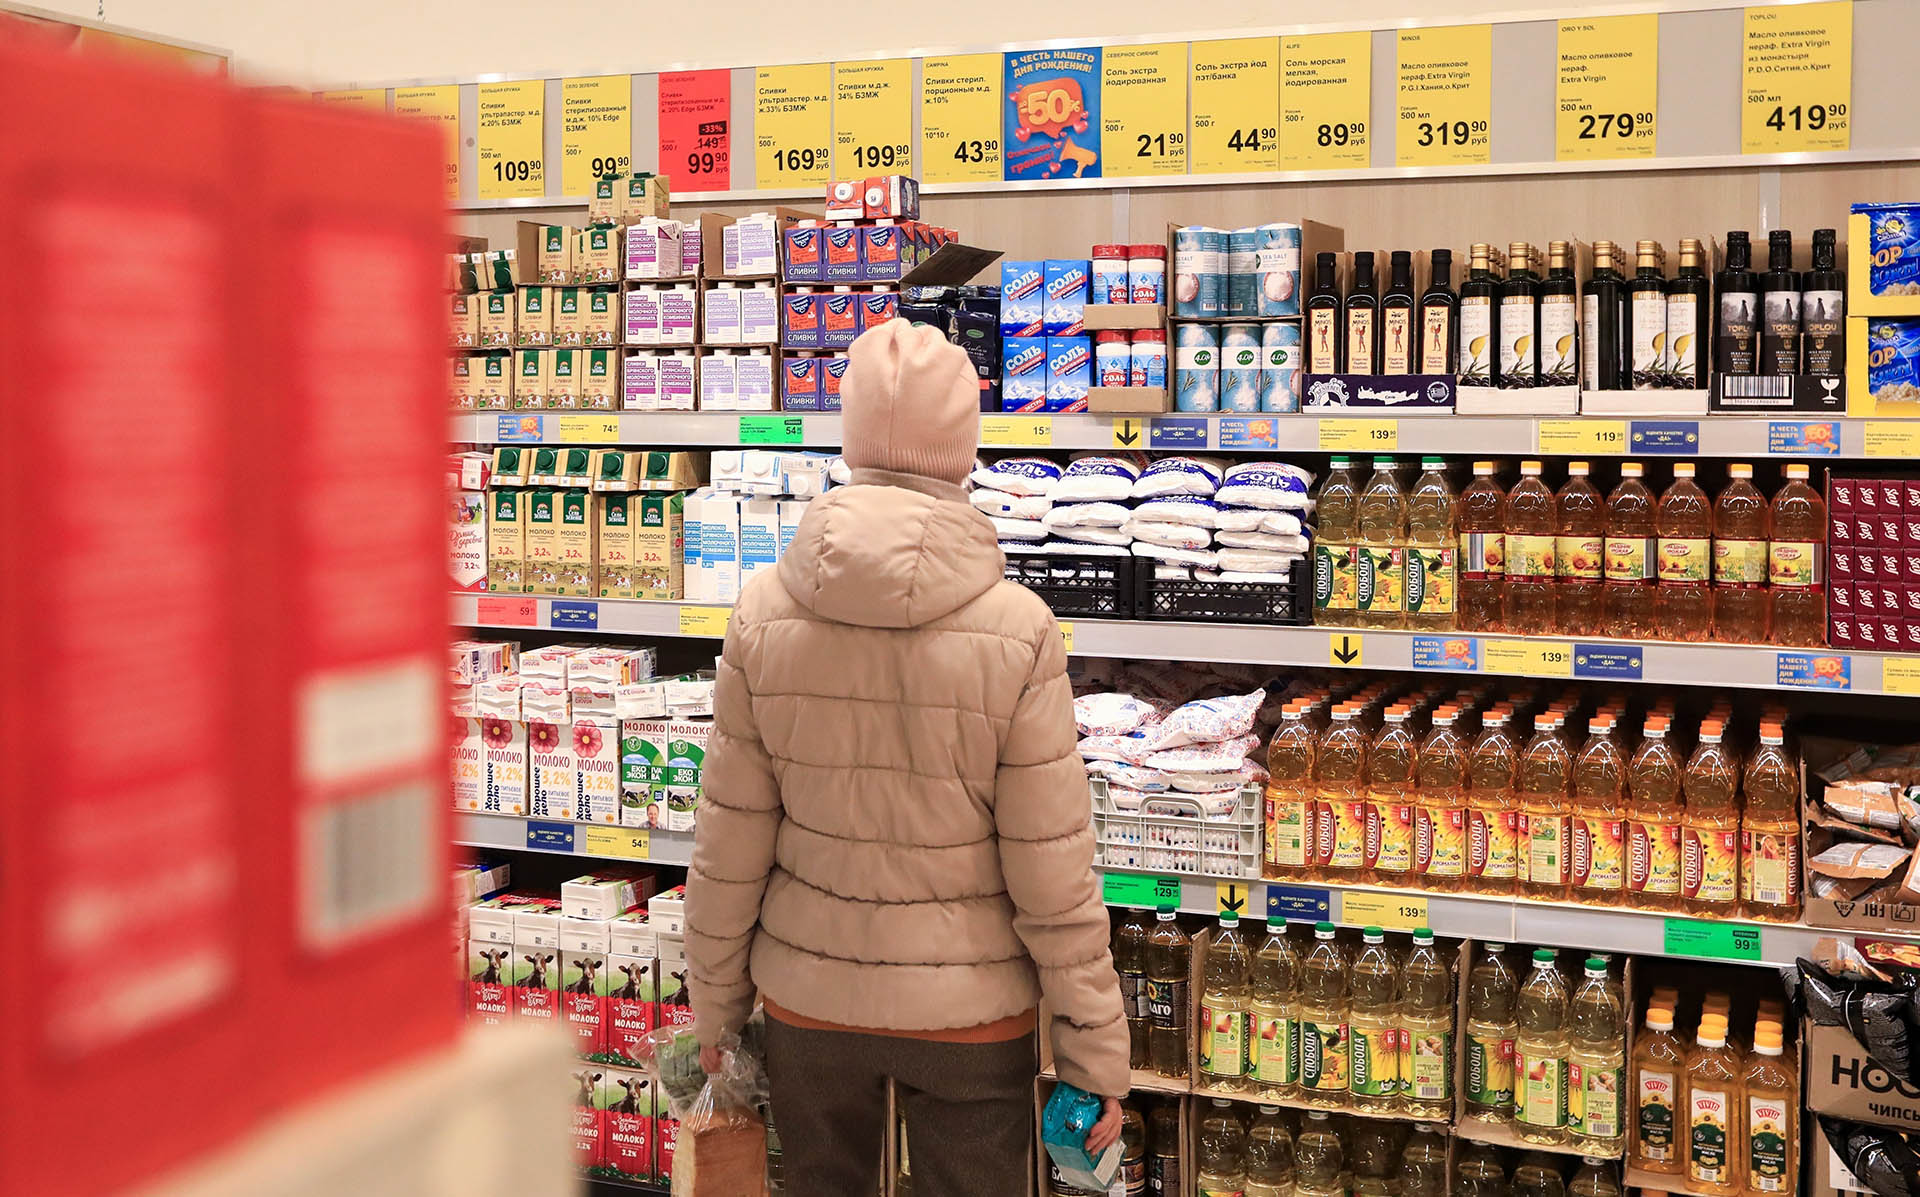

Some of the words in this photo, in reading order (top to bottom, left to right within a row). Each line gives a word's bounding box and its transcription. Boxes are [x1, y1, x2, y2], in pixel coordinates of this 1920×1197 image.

[1749, 31, 1776, 39] Масло
[1779, 29, 1826, 38] оливковое
[1781, 41, 1804, 49] Extra
[1806, 39, 1831, 48] Virgin
[1011, 59, 1018, 67] В
[1020, 52, 1050, 63] ЧЕСТЬ
[1054, 51, 1094, 62] НАШЕГО
[1286, 59, 1307, 67] Соль
[1310, 57, 1346, 66] морская
[1561, 54, 1586, 62] Масло
[1589, 52, 1632, 60] оливковое
[1760, 52, 1809, 61] монастыря
[1014, 66, 1033, 78] ДНЯ
[1035, 61, 1092, 72] РОЖДЕНИЯ!
[1195, 64, 1217, 72] Соль
[1220, 61, 1248, 70] экстра
[1251, 59, 1267, 68] йод
[1401, 62, 1424, 70] Масло
[1427, 60, 1468, 68] оливковое
[1106, 68, 1127, 76] Соль
[1130, 67, 1157, 75] экстра
[1195, 72, 1236, 81] пэт/банка
[1286, 69, 1318, 77] мелкая,
[1448, 70, 1470, 79] Virgin
[925, 77, 953, 86] Сливки
[957, 77, 986, 85] стерил.
[1106, 76, 1167, 86] йодированная
[1286, 76, 1347, 87] йодированная
[1561, 76, 1581, 84] Extra
[1584, 74, 1606, 83] Virgin
[759, 87, 787, 95] Сливки
[855, 91, 879, 99] БЗМЖ
[925, 87, 975, 96] порционные
[566, 105, 626, 114] стерилизованные
[783, 104, 807, 112] БЗМЖ
[1828, 104, 1846, 116] 90
[603, 114, 619, 122] Edge
[1636, 112, 1652, 124] 90
[1766, 105, 1826, 131] 419
[701, 124, 724, 132] -33%
[1350, 123, 1364, 134] 90
[1471, 121, 1487, 132] 90
[1579, 113, 1634, 139] 279
[1828, 121, 1846, 130] руб
[1169, 133, 1184, 144] 90
[1261, 128, 1276, 139] 90
[1317, 124, 1348, 146] 89
[1417, 121, 1470, 146] 319
[1636, 128, 1653, 138] руб
[1137, 133, 1165, 157] 21
[1228, 128, 1260, 152] 44
[1351, 137, 1365, 145] руб
[1472, 136, 1487, 145] руб
[896, 144, 909, 155] 90
[954, 140, 983, 163] 43
[985, 139, 997, 151] 90
[1170, 147, 1184, 155] руб
[1262, 142, 1276, 151] руб
[774, 148, 815, 171] 169
[816, 148, 828, 158] 90
[854, 145, 895, 168] 199
[592, 157, 617, 178] 99
[618, 157, 629, 166] 90
[688, 153, 714, 174] 99
[715, 152, 728, 162] 90
[896, 159, 909, 167] руб
[494, 161, 529, 181] 109
[530, 160, 541, 170] 90
[1004, 270, 1039, 295] СОЛЬ
[1047, 269, 1082, 295] СОЛЬ
[1006, 346, 1041, 371] СОЛЬ
[1050, 346, 1086, 371] СОЛЬ
[786, 426, 796, 435] 54
[1033, 426, 1044, 435] 15
[1370, 430, 1388, 440] 139
[1596, 432, 1616, 442] 119
[534, 548, 551, 556] 3,2%
[608, 551, 625, 560] 3,2%
[644, 553, 661, 562] 3,2%
[1541, 653, 1561, 662] 139
[624, 723, 665, 732] МОЛОКО
[487, 750, 522, 764] МОЛОКО
[534, 755, 570, 768] МОЛОКО
[577, 759, 613, 772] МОЛОКО
[495, 766, 523, 781] 3,2%
[542, 770, 570, 786] 3,2%
[585, 775, 615, 791] 3,2%
[533, 767, 541, 815] Хорошее
[576, 772, 584, 820] Хорошее
[584, 795, 592, 820] дело
[1685, 839, 1697, 888] СЛОБОДА
[1153, 887, 1172, 897] 129
[1398, 907, 1418, 918] 139
[1735, 939, 1749, 950] 99
[1696, 1100, 1720, 1112] VIVID
[1756, 1109, 1780, 1120] VIVID
